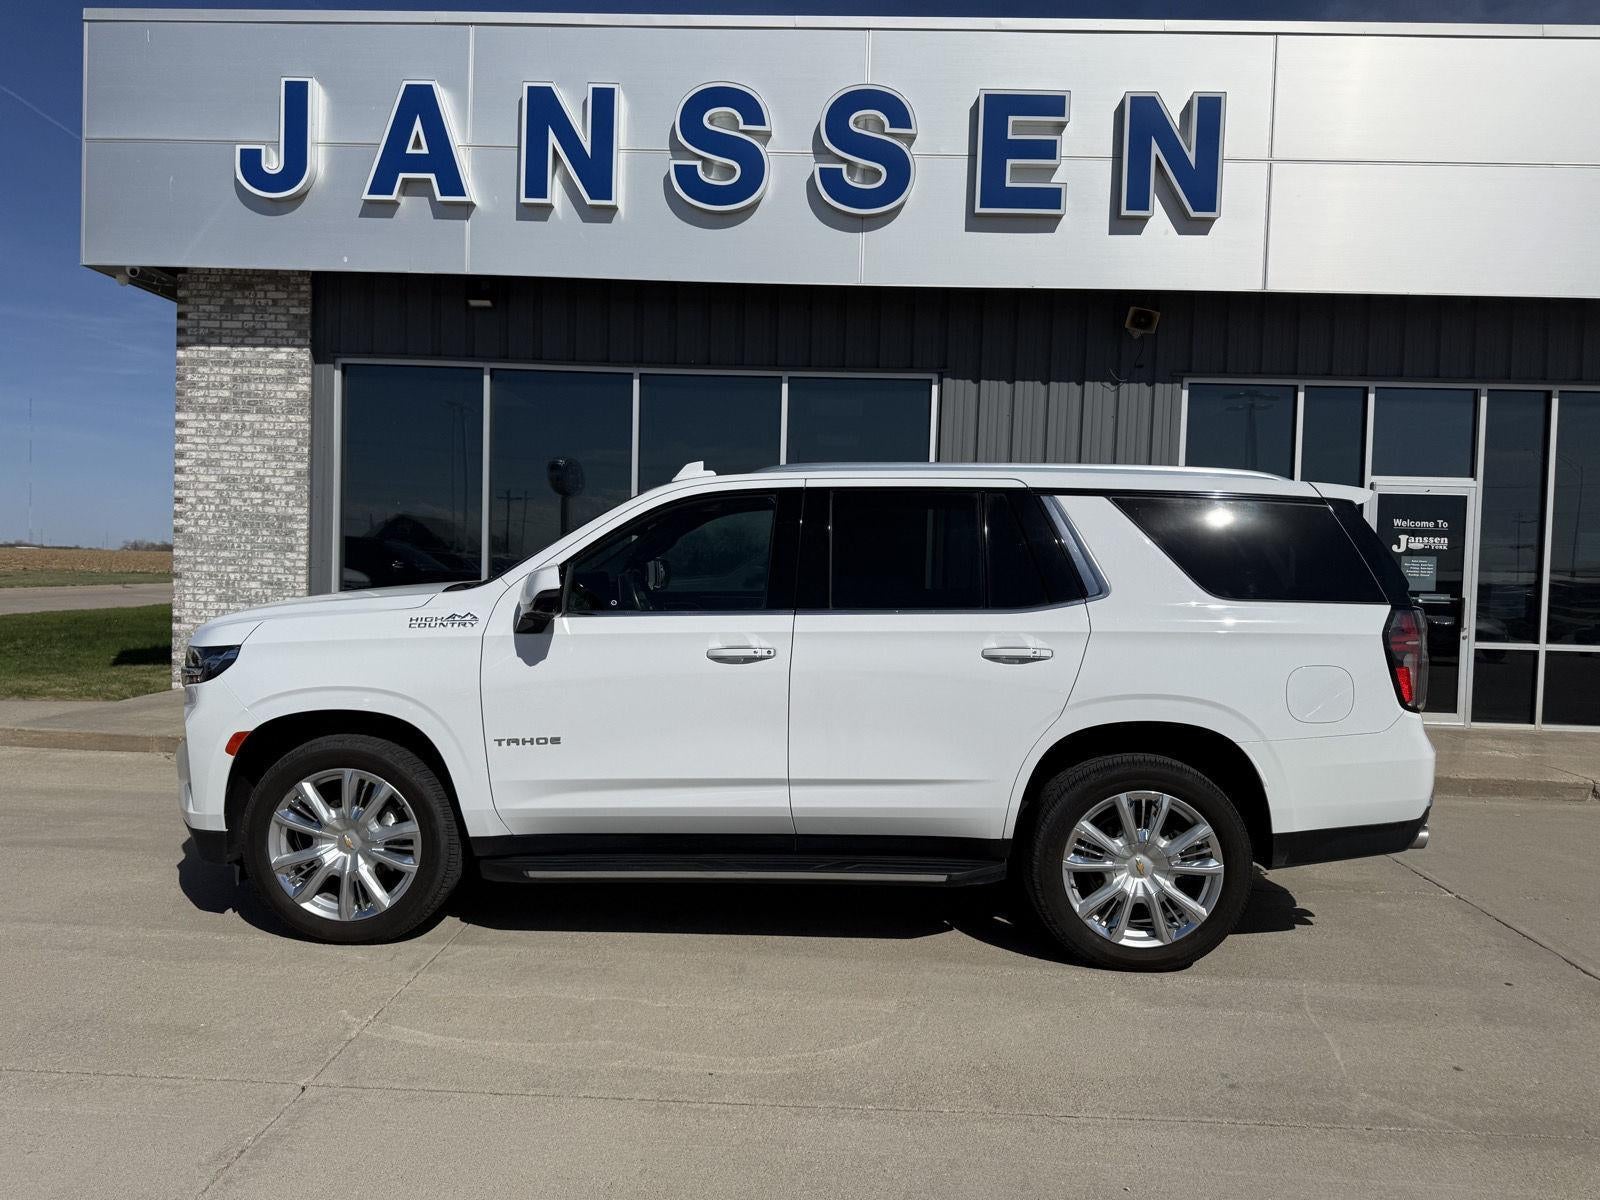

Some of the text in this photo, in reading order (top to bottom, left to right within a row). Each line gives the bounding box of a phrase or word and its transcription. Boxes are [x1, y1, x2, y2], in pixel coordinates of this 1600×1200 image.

[235, 77, 1227, 219] JANSSEN
[1393, 519, 1449, 528] Welcome To
[1392, 534, 1448, 553] Janssen
[408, 621, 478, 629] COUNTRY
[493, 736, 562, 747] TAHOE
